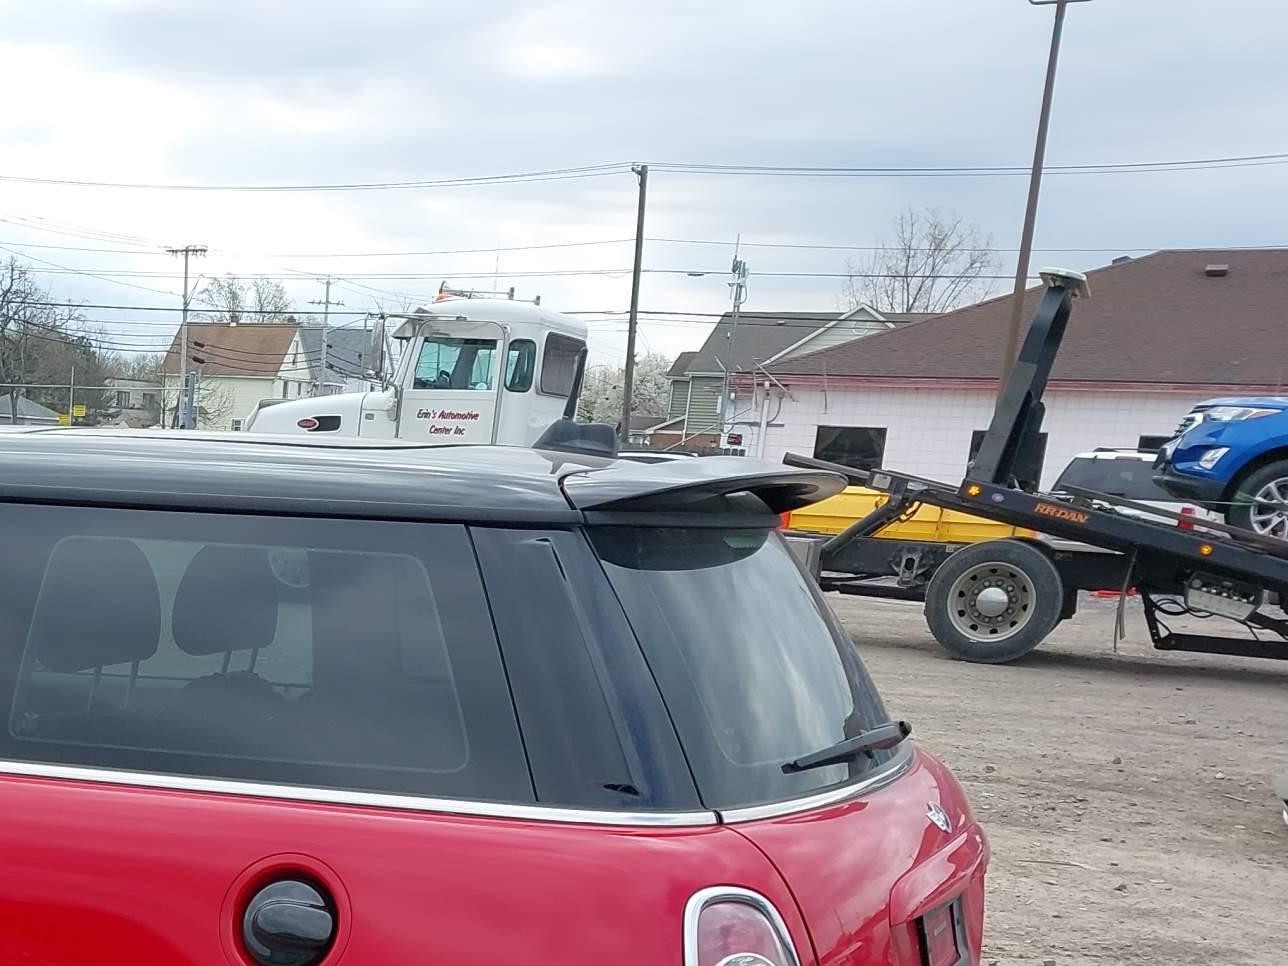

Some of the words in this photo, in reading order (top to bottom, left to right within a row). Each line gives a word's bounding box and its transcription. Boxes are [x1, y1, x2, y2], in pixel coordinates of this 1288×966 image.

[438, 410, 480, 420] Automotive
[429, 425, 452, 435] Center
[454, 426, 466, 435] Inc
